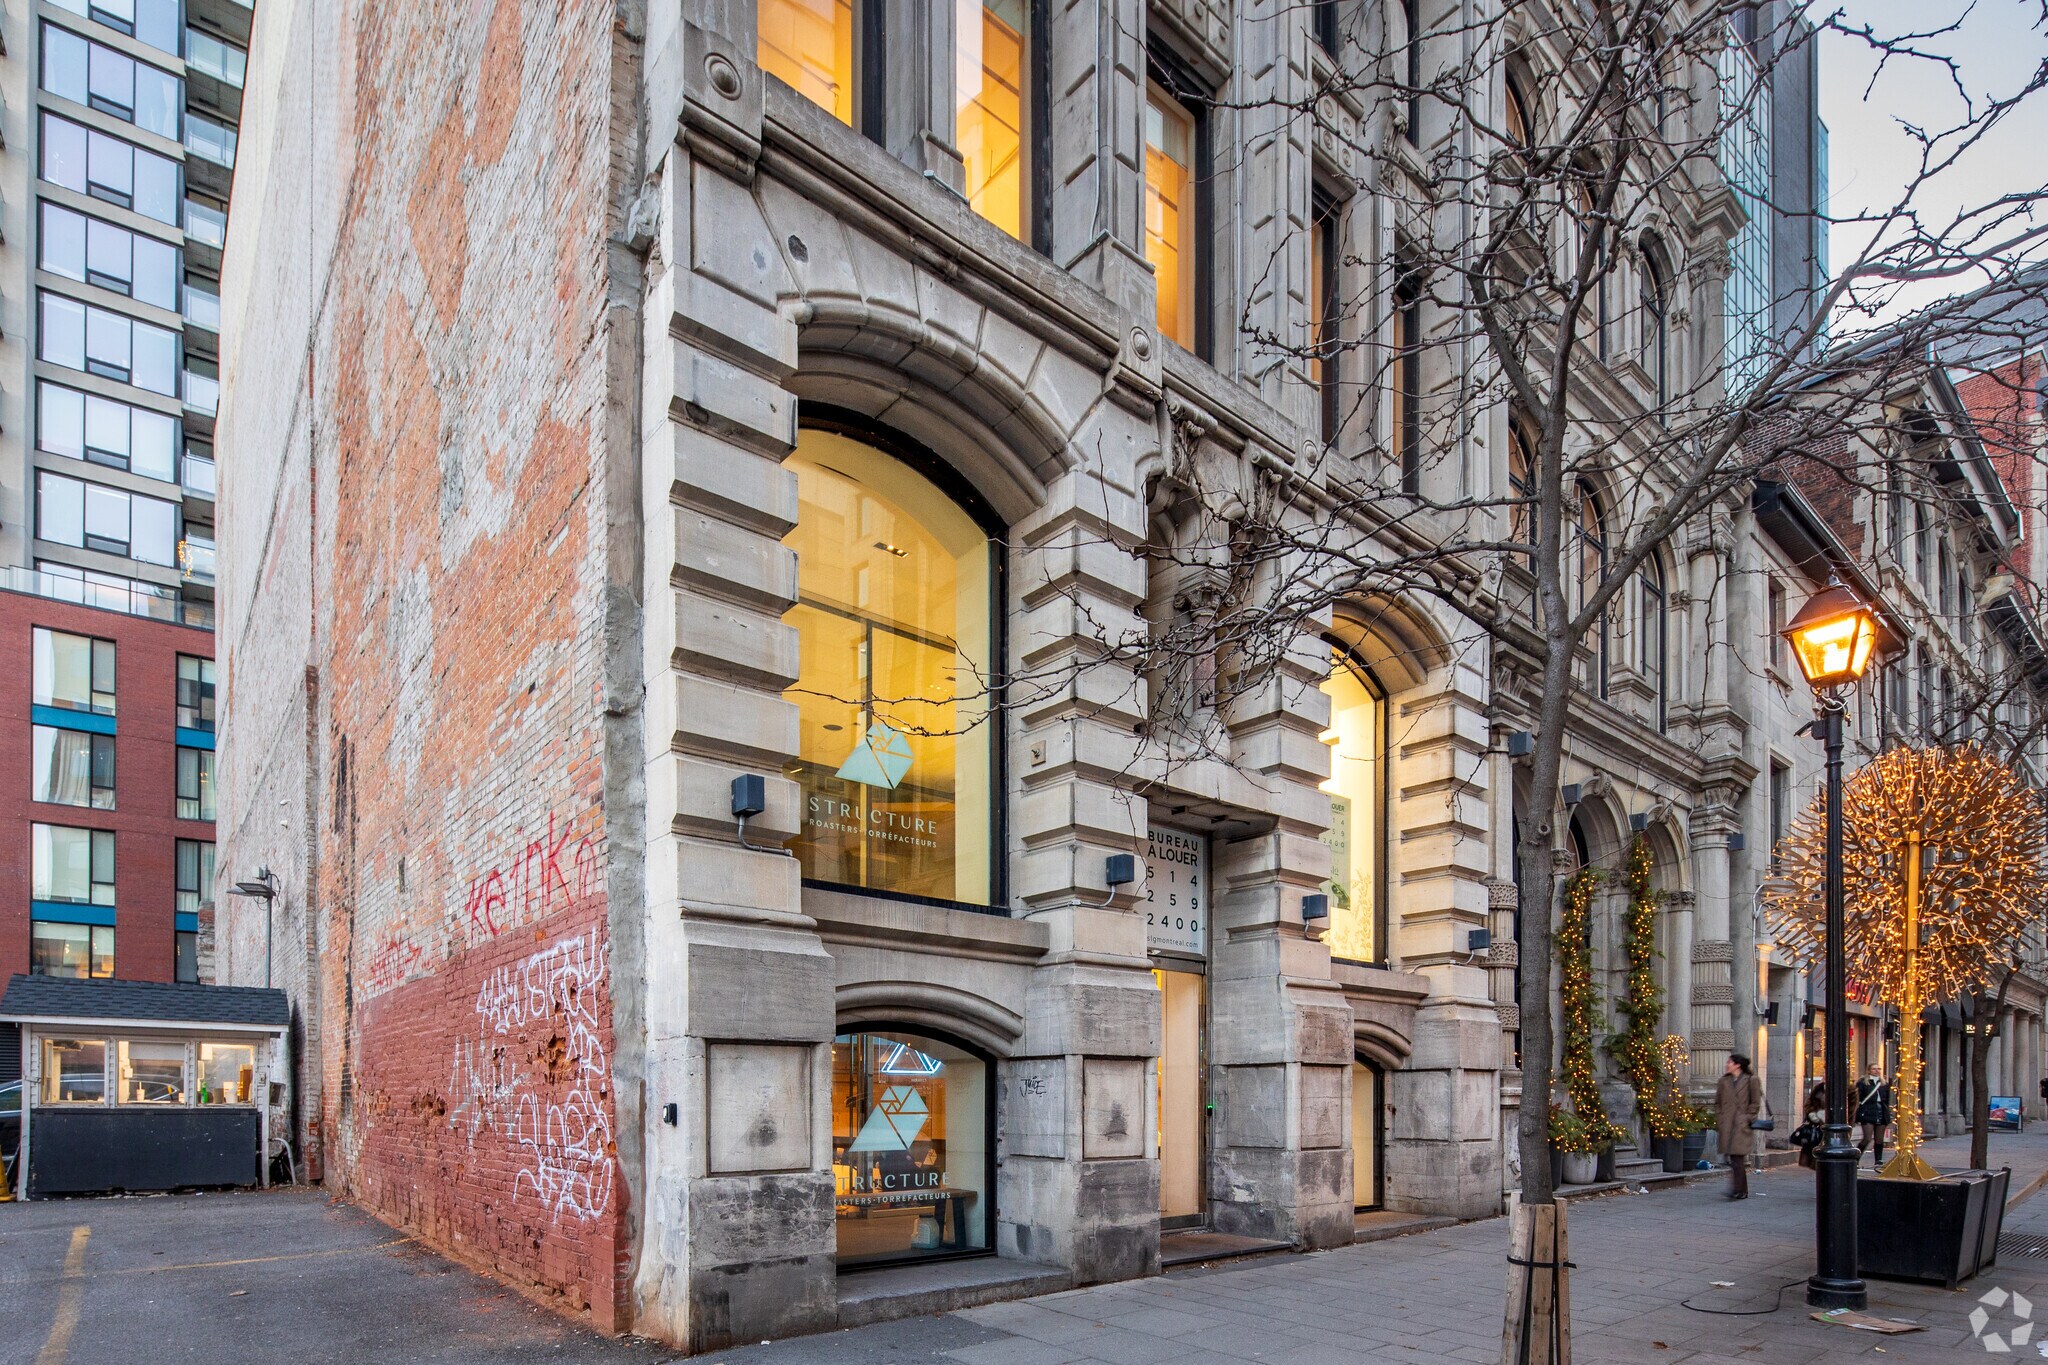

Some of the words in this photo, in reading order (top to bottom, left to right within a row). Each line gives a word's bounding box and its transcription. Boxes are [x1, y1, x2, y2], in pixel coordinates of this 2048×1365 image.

[809, 796, 937, 835] STRUCTURE
[1148, 831, 1198, 851] BUREAU
[1148, 841, 1157, 858] À
[1159, 846, 1198, 867] LOUER
[838, 1172, 951, 1191] TRUCTURE
[837, 1196, 872, 1206] ASTERS
